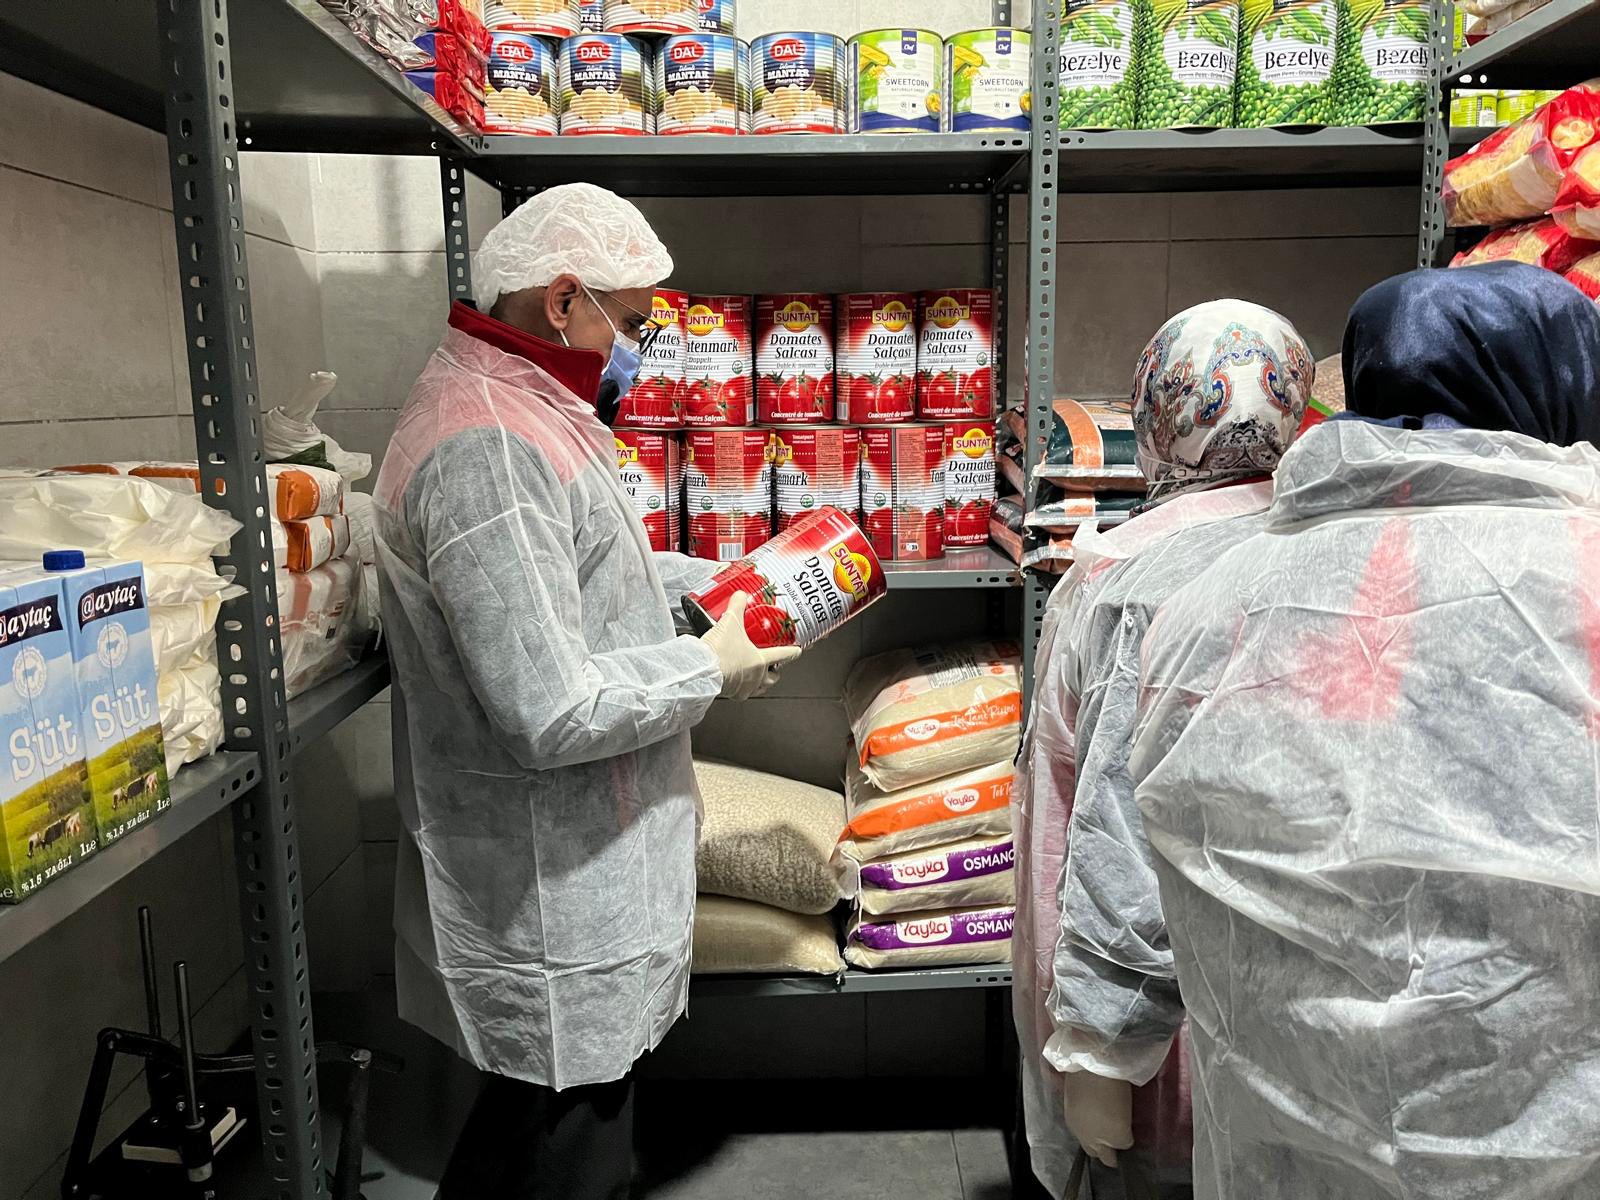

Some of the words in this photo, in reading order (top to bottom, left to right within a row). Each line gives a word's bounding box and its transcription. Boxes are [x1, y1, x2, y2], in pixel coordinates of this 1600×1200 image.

[700, 20, 717, 28] TAR
[502, 46, 528, 59] DAL
[581, 47, 607, 59] DAL
[674, 46, 701, 59] DAL
[774, 44, 802, 56] DAL
[1060, 52, 1121, 73] Bezelye
[1178, 51, 1235, 72] Bezelye
[1265, 49, 1329, 69] Bezelye
[1376, 48, 1428, 68] Bezely
[494, 70, 538, 82] MANTAR
[575, 71, 616, 81] MANTAR
[667, 71, 709, 82] MANTAR
[767, 69, 810, 80] MANTAR
[886, 78, 929, 87] SWEETCORN
[979, 78, 1024, 87] SWEETCORN
[651, 310, 675, 320] NTAT
[776, 312, 816, 322] SUNTAT
[875, 312, 911, 322] SUNTAT
[927, 307, 967, 318] SUNTAT
[687, 315, 720, 325] UNTAT
[654, 331, 680, 346] ates
[770, 333, 822, 345] Domates
[923, 330, 973, 342] Domates
[644, 346, 676, 360] lçası
[873, 346, 911, 360] Salçası
[927, 343, 967, 356] Salçası
[956, 438, 990, 448] SUNTAT
[616, 450, 634, 458] TAT
[954, 473, 991, 486] Salçası
[836, 548, 866, 595] SUNTAT
[804, 556, 842, 619] Domates
[793, 571, 827, 624] Salçası
[91, 683, 150, 741] Süt
[10, 713, 77, 781] Süt
[948, 793, 975, 807] Yayla
[127, 810, 150, 830] YAĞLI
[45, 855, 73, 879] YAĞLI
[966, 919, 1014, 935] OSMAN
